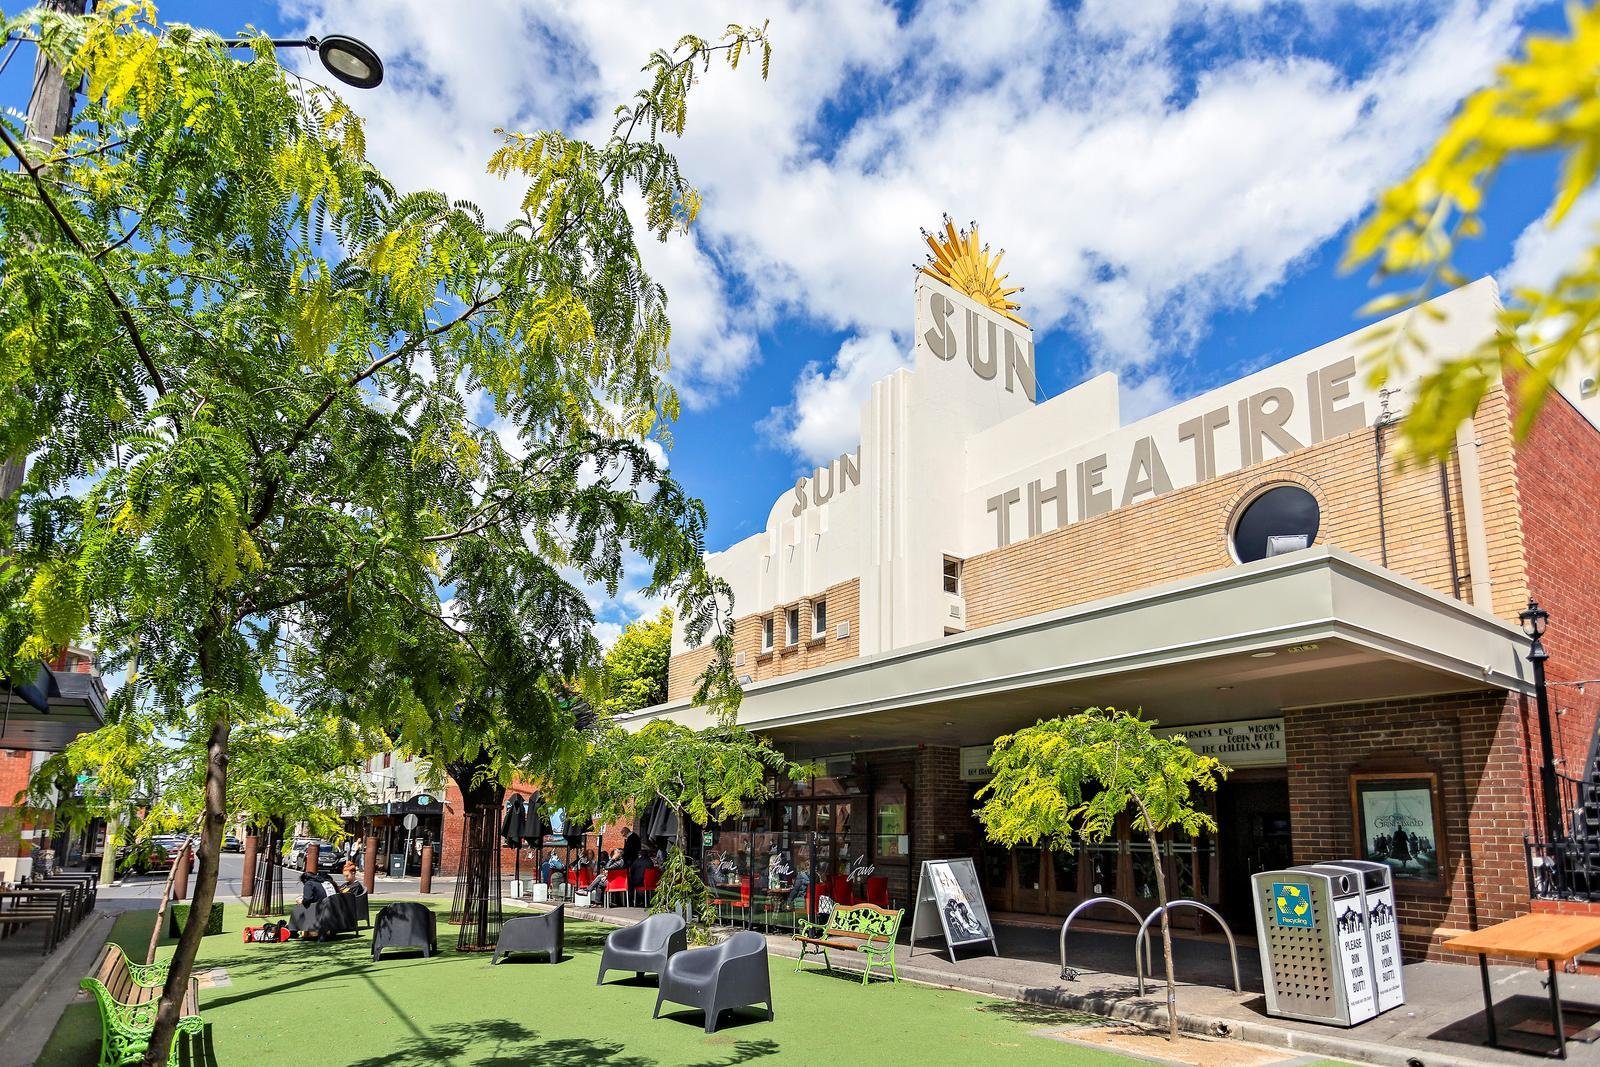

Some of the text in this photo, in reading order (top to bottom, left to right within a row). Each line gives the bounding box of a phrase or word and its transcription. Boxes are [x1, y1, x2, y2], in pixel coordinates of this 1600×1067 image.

[924, 292, 1036, 403] SUN
[986, 355, 1366, 548] THEATRE
[792, 445, 860, 517] SUN
[1247, 723, 1279, 732] WIDOWS
[1265, 740, 1279, 749] ACT
[1376, 930, 1391, 942] PLEASE
[1345, 938, 1362, 950] PLEASE
[1351, 953, 1359, 964] BIN
[1382, 956, 1392, 968] YOUR
[1351, 966, 1363, 978] YOUR
